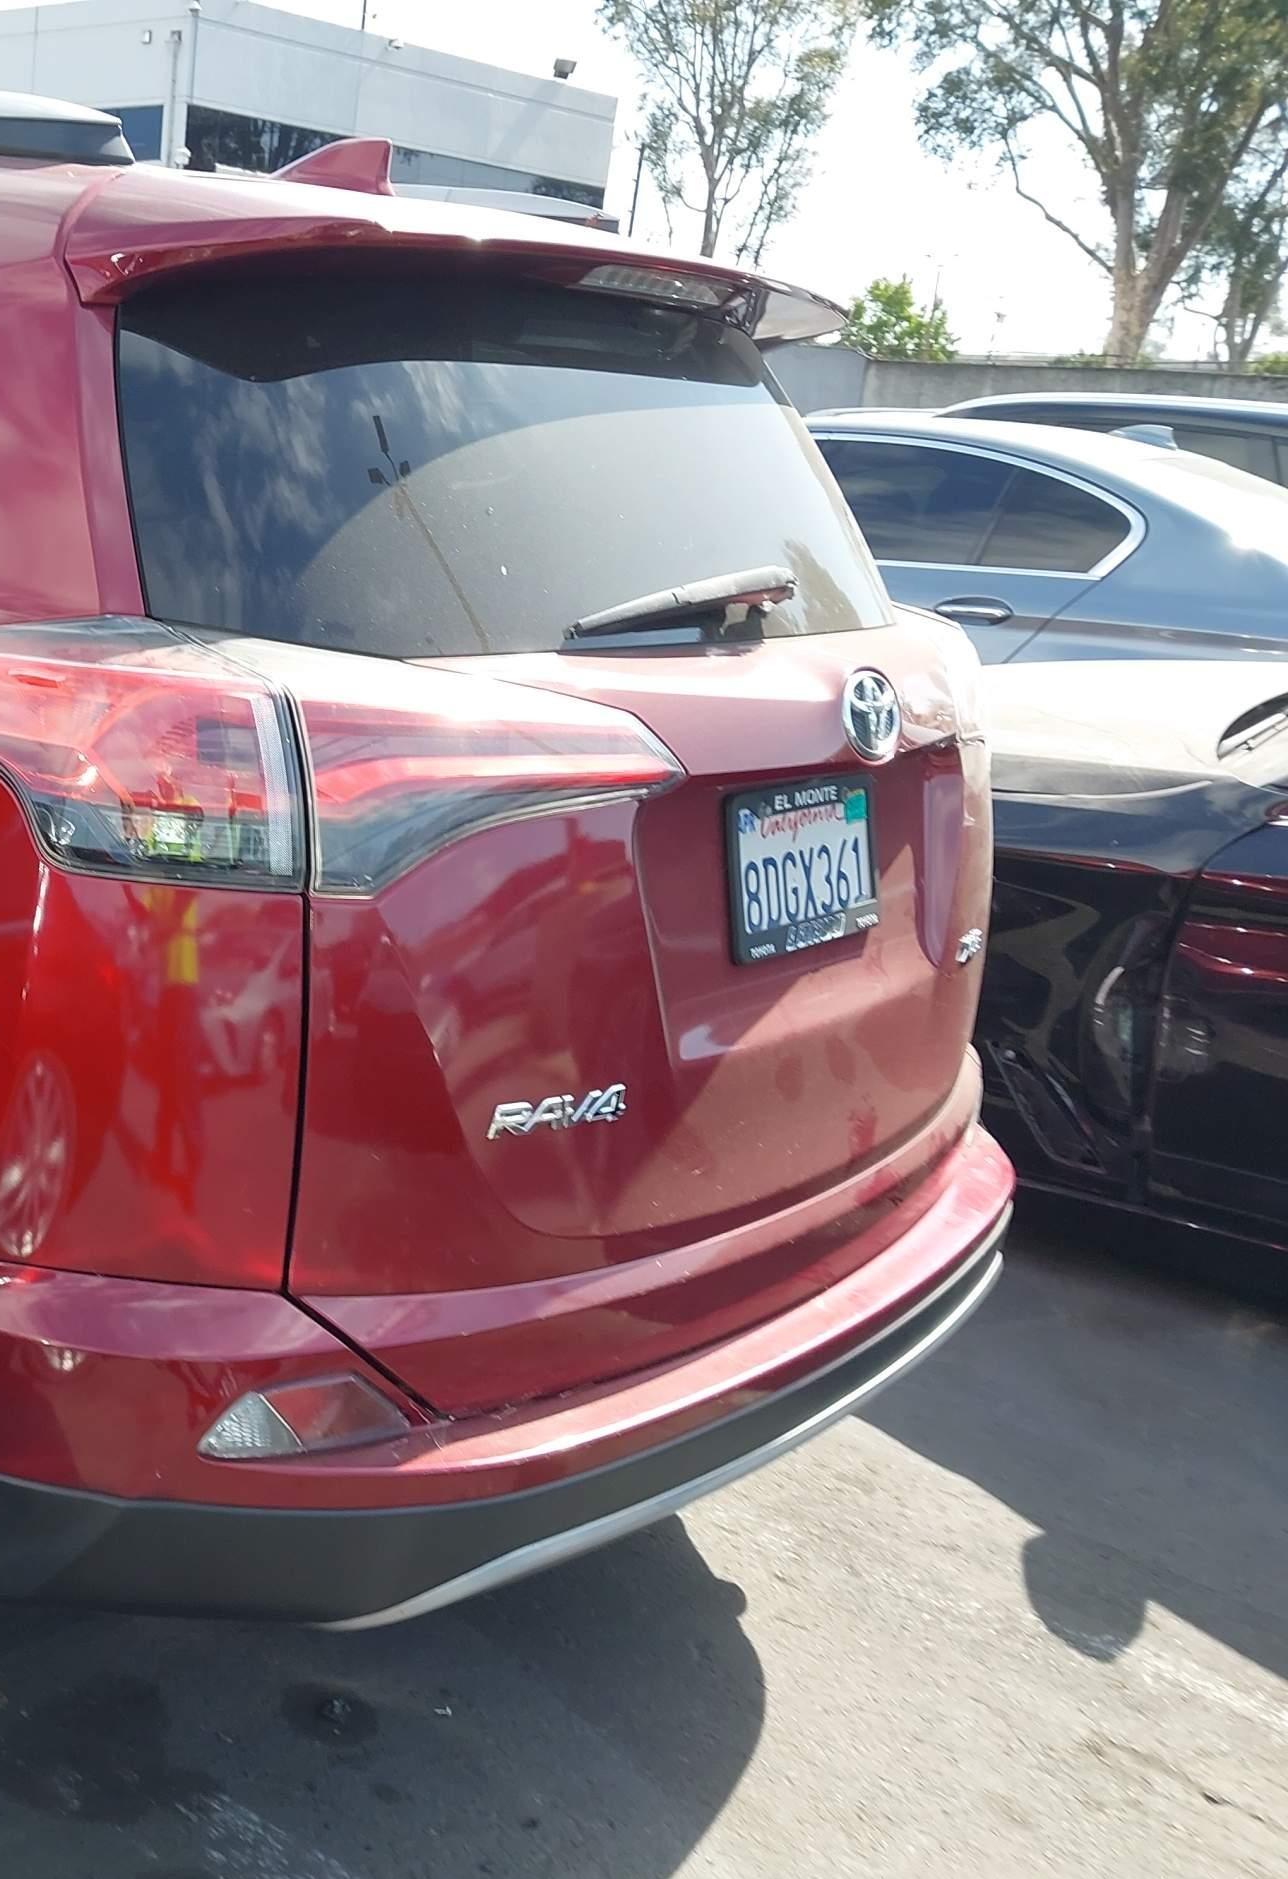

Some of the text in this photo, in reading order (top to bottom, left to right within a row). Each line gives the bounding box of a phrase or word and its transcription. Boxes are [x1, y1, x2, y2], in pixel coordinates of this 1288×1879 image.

[774, 785, 838, 811] EL MONTE
[744, 836, 867, 934] 8DGX361
[486, 1083, 627, 1140] RAV4
